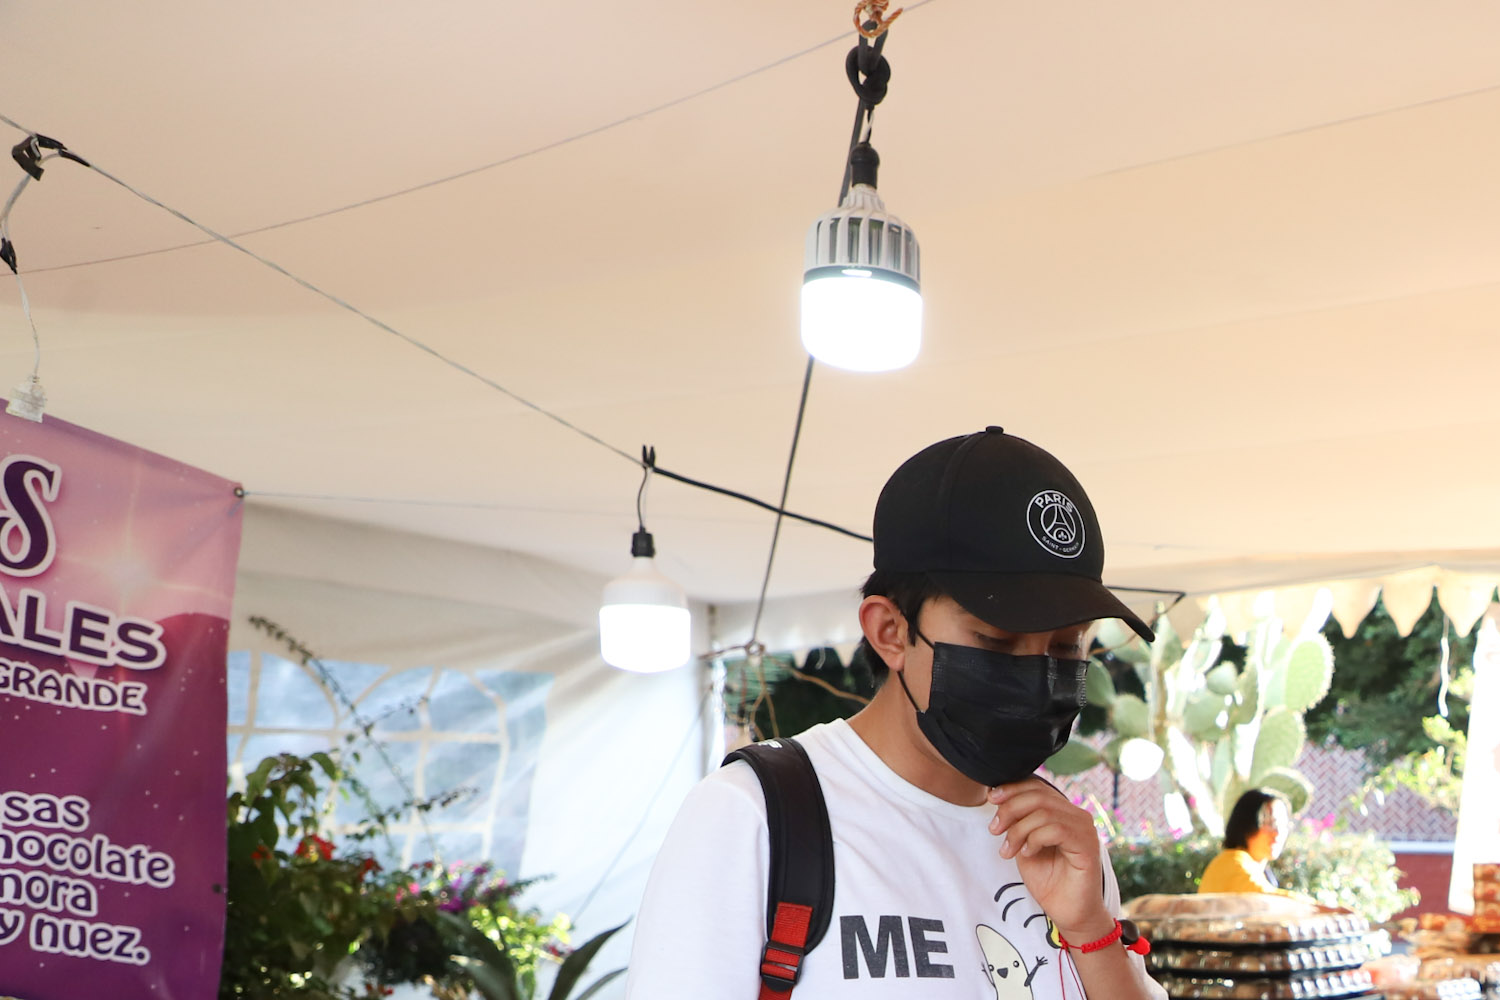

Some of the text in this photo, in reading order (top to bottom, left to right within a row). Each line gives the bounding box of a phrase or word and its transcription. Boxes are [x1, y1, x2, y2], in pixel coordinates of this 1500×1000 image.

[1034, 493, 1073, 512] PARIS
[34, 915, 148, 962] nuez.
[840, 914, 956, 980] ME
